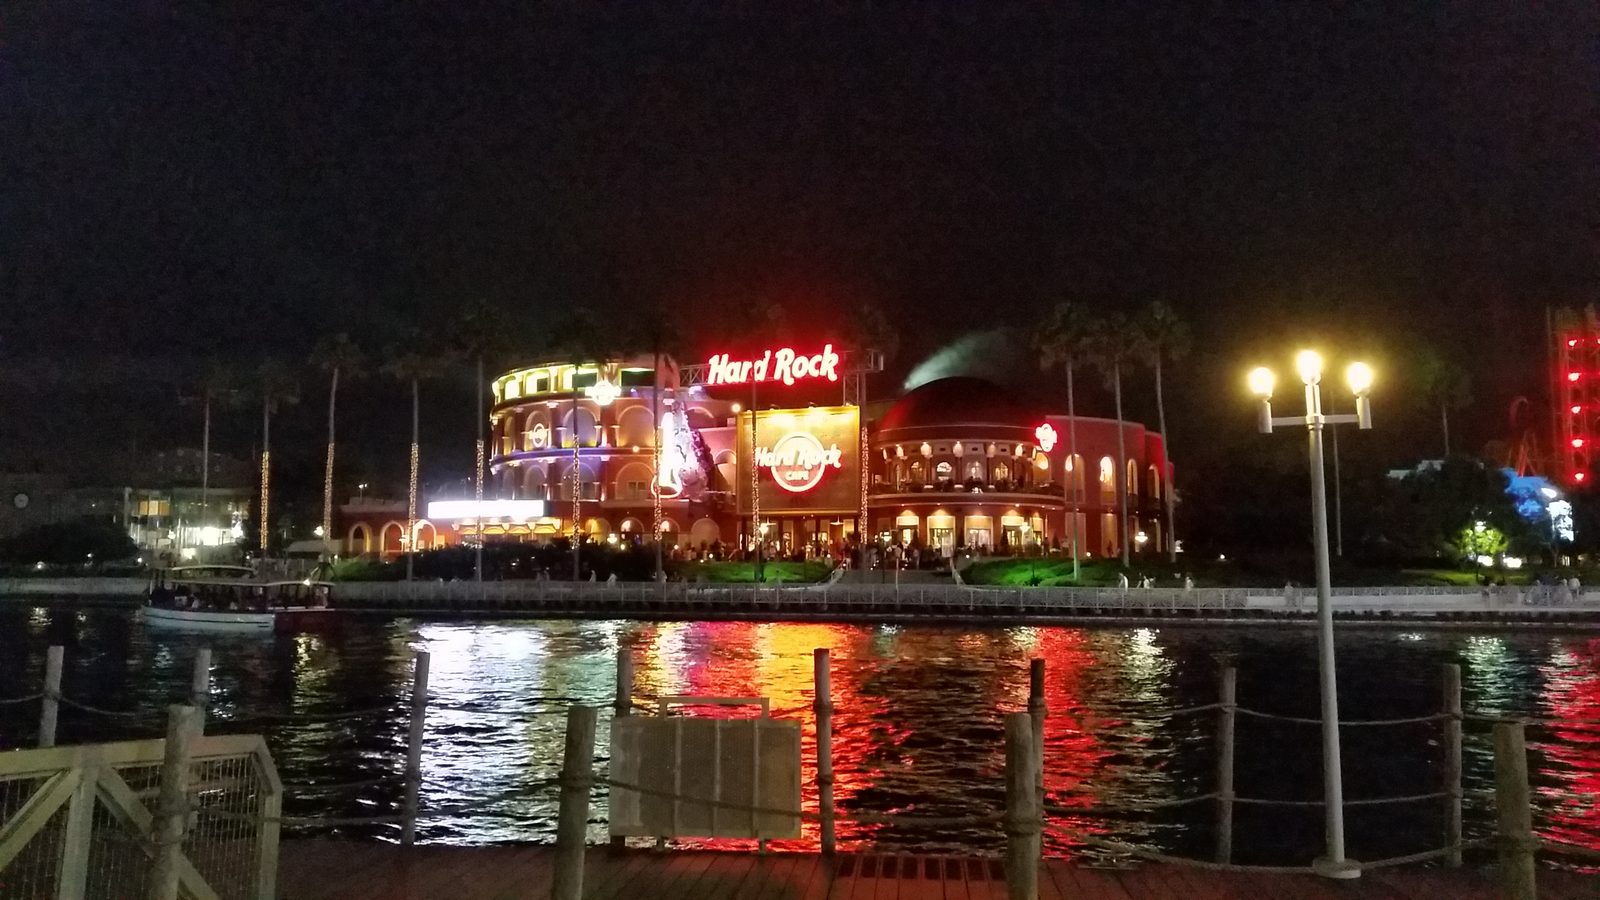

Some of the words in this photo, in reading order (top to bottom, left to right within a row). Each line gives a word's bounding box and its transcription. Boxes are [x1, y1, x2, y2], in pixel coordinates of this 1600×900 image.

[707, 350, 771, 385] Hard
[774, 344, 839, 386] Rock
[755, 446, 797, 467] Hard
[797, 443, 842, 469] Rock
